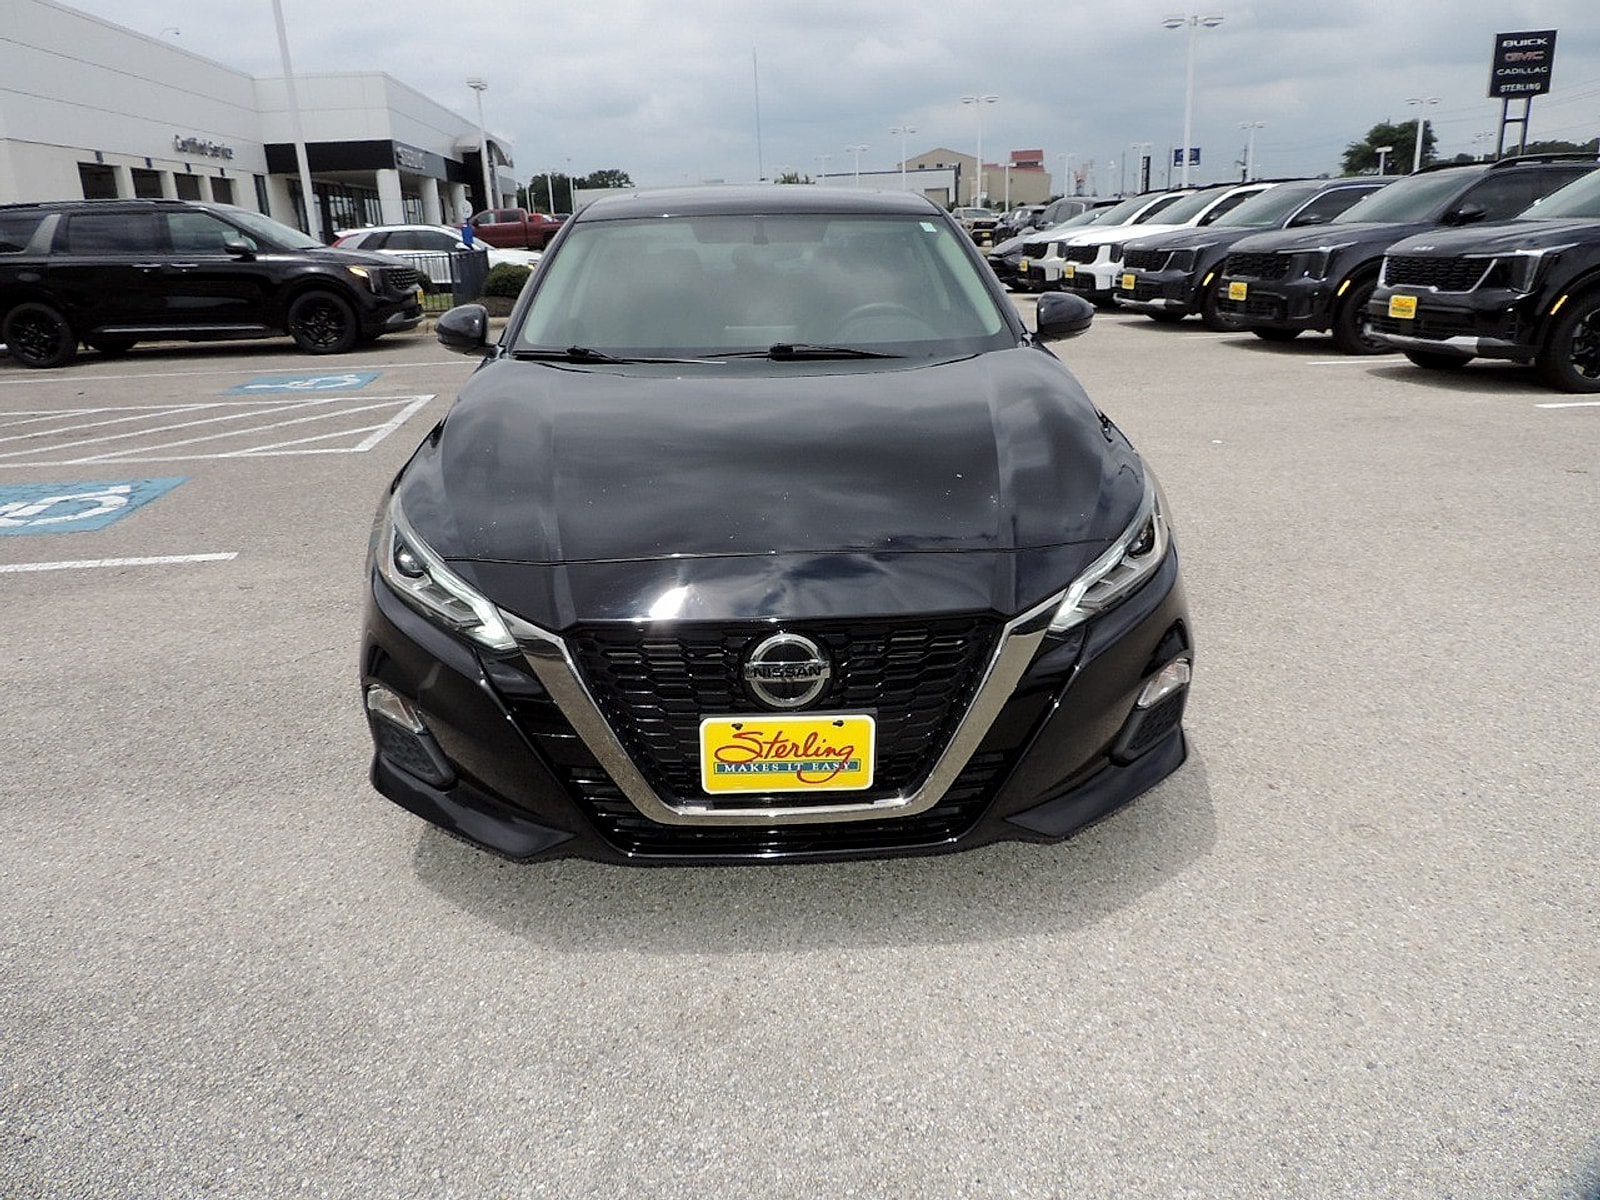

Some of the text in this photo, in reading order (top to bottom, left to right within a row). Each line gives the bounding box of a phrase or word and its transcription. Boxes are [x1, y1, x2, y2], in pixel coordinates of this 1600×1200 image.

[1502, 38, 1548, 47] BUICK
[1505, 50, 1545, 61] GMC
[1496, 66, 1548, 75] CADILLAC
[1500, 83, 1541, 92] STERLING
[753, 665, 822, 678] NISSAN
[714, 730, 855, 784] Sterling
[724, 761, 851, 773] MAKES IT EASY
